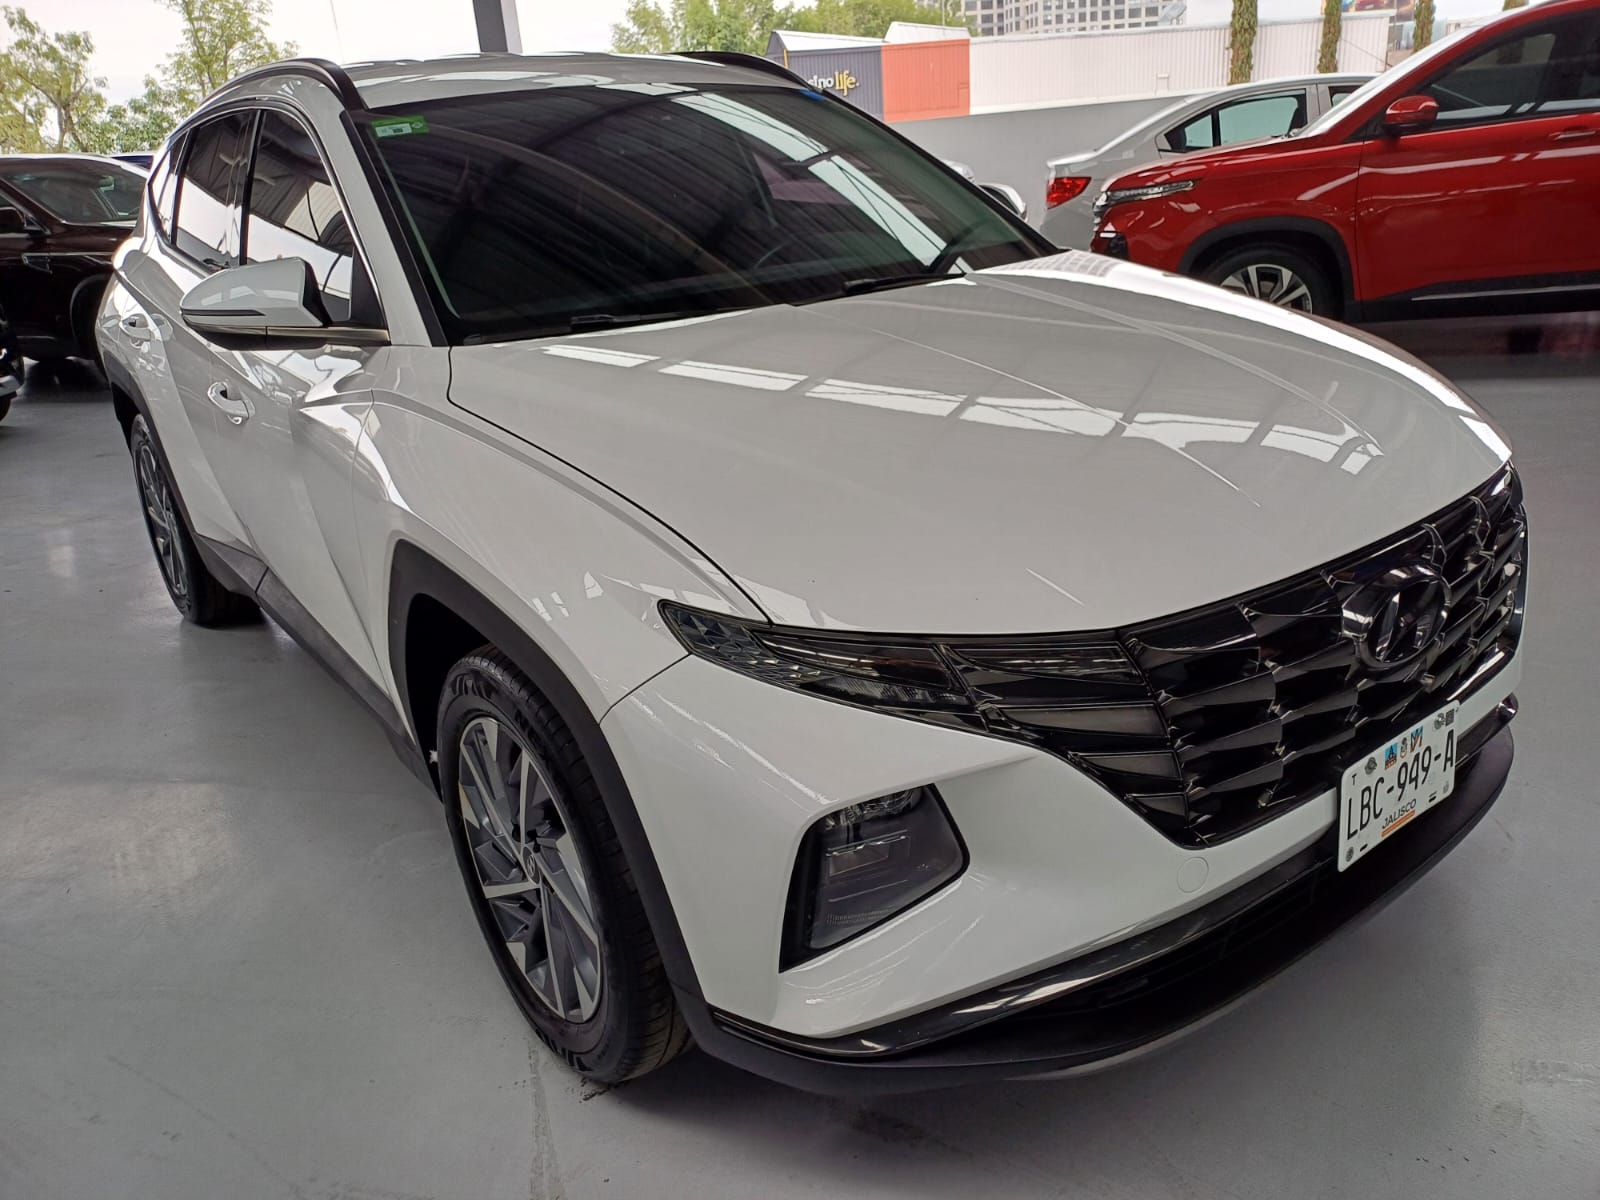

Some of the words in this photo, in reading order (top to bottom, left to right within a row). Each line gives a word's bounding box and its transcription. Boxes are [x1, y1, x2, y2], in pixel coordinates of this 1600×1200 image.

[805, 74, 834, 89] sino
[1347, 729, 1455, 841] LBC-949-A
[1382, 798, 1417, 829] JALISCO
